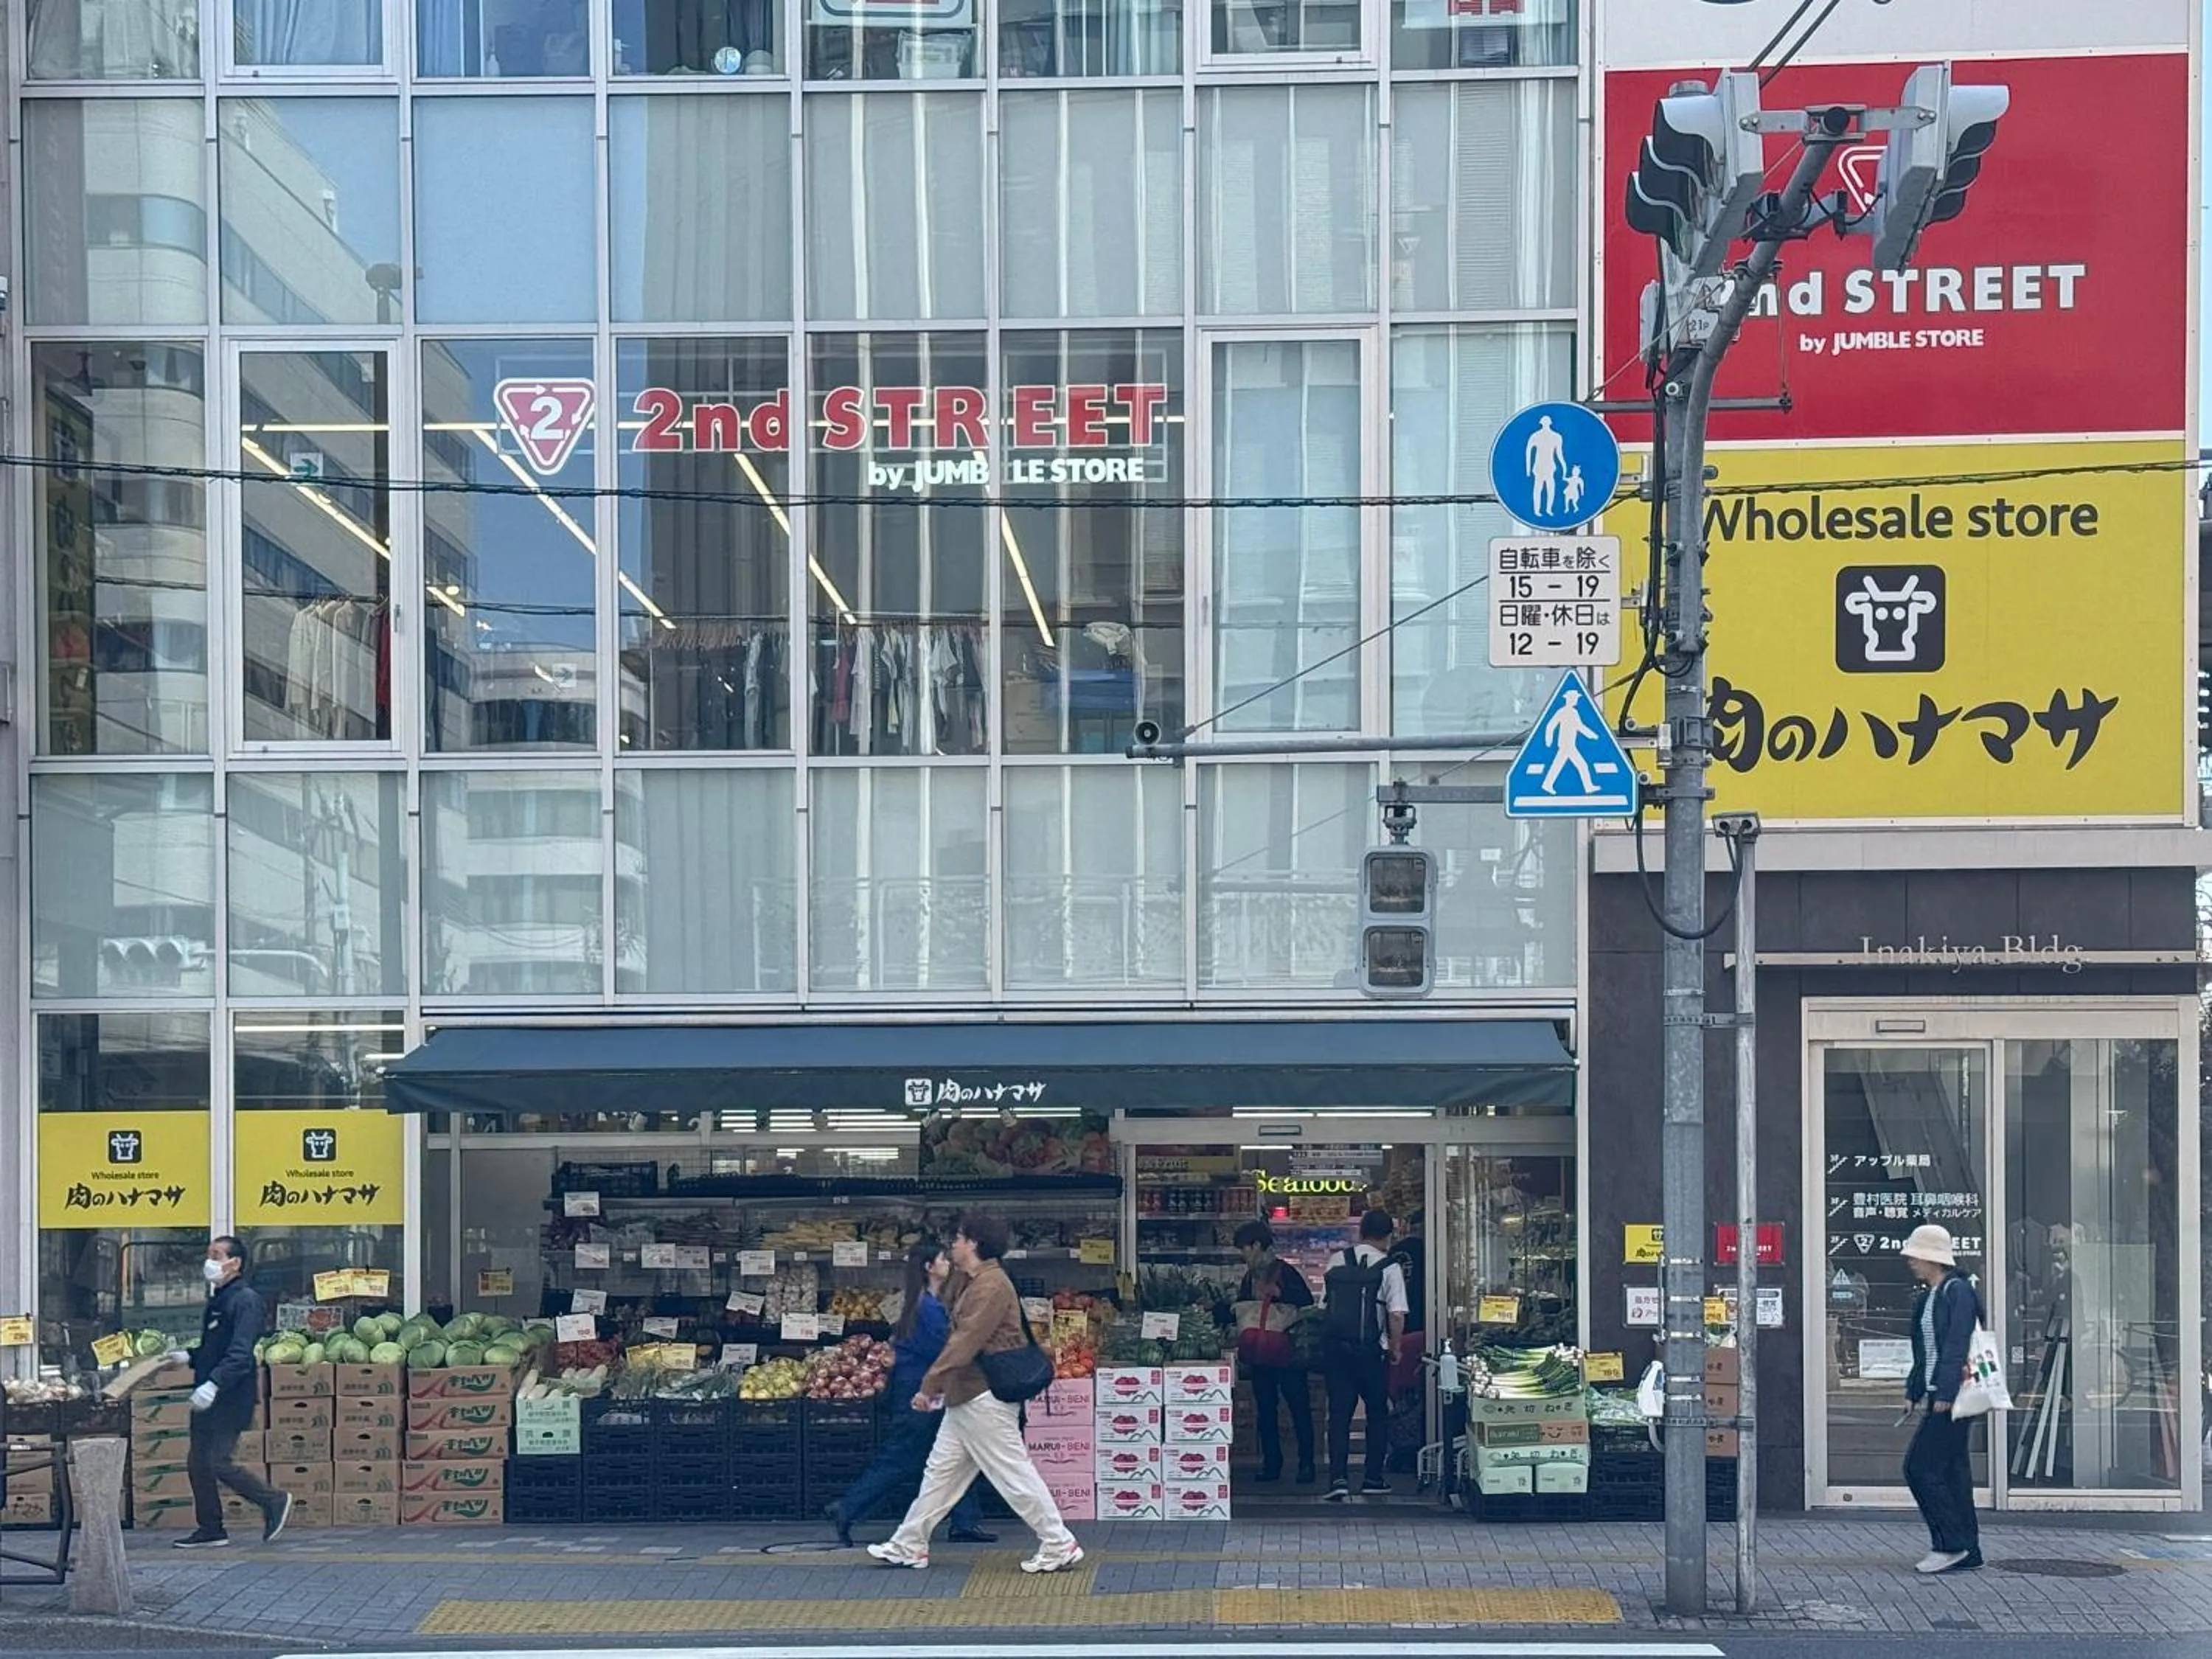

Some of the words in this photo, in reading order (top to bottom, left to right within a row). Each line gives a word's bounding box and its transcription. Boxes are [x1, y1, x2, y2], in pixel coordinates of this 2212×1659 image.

[1844, 265, 2086, 314] STREET
[1800, 334, 1826, 354] by
[1832, 331, 1911, 356] JUMBLE
[1915, 329, 1984, 348] STORE
[633, 388, 790, 452] 2nd
[822, 383, 1167, 450] STREET
[868, 462, 904, 490] by
[1051, 458, 1144, 482] STORE
[1702, 494, 1954, 542] Wholesale
[1967, 498, 2098, 537] store
[1500, 546, 1610, 570] 自転車を除く
[1510, 575, 1532, 598] 15
[1577, 575, 1599, 598] 19
[1500, 604, 1610, 627] 日曜・休日は
[1510, 633, 1532, 655] 12
[1577, 632, 1599, 655] 19
[1707, 676, 2119, 773] 肉のハナマサ
[1860, 936, 1986, 973] Inakiya
[935, 1078, 1047, 1104] 肉のハナマサ
[91, 1171, 136, 1180] Wholesale
[285, 1169, 330, 1178] Wholesale
[332, 1170, 354, 1178] store
[65, 1183, 187, 1209] 肉のハナマサ
[260, 1180, 380, 1207] 肉のハナマサ
